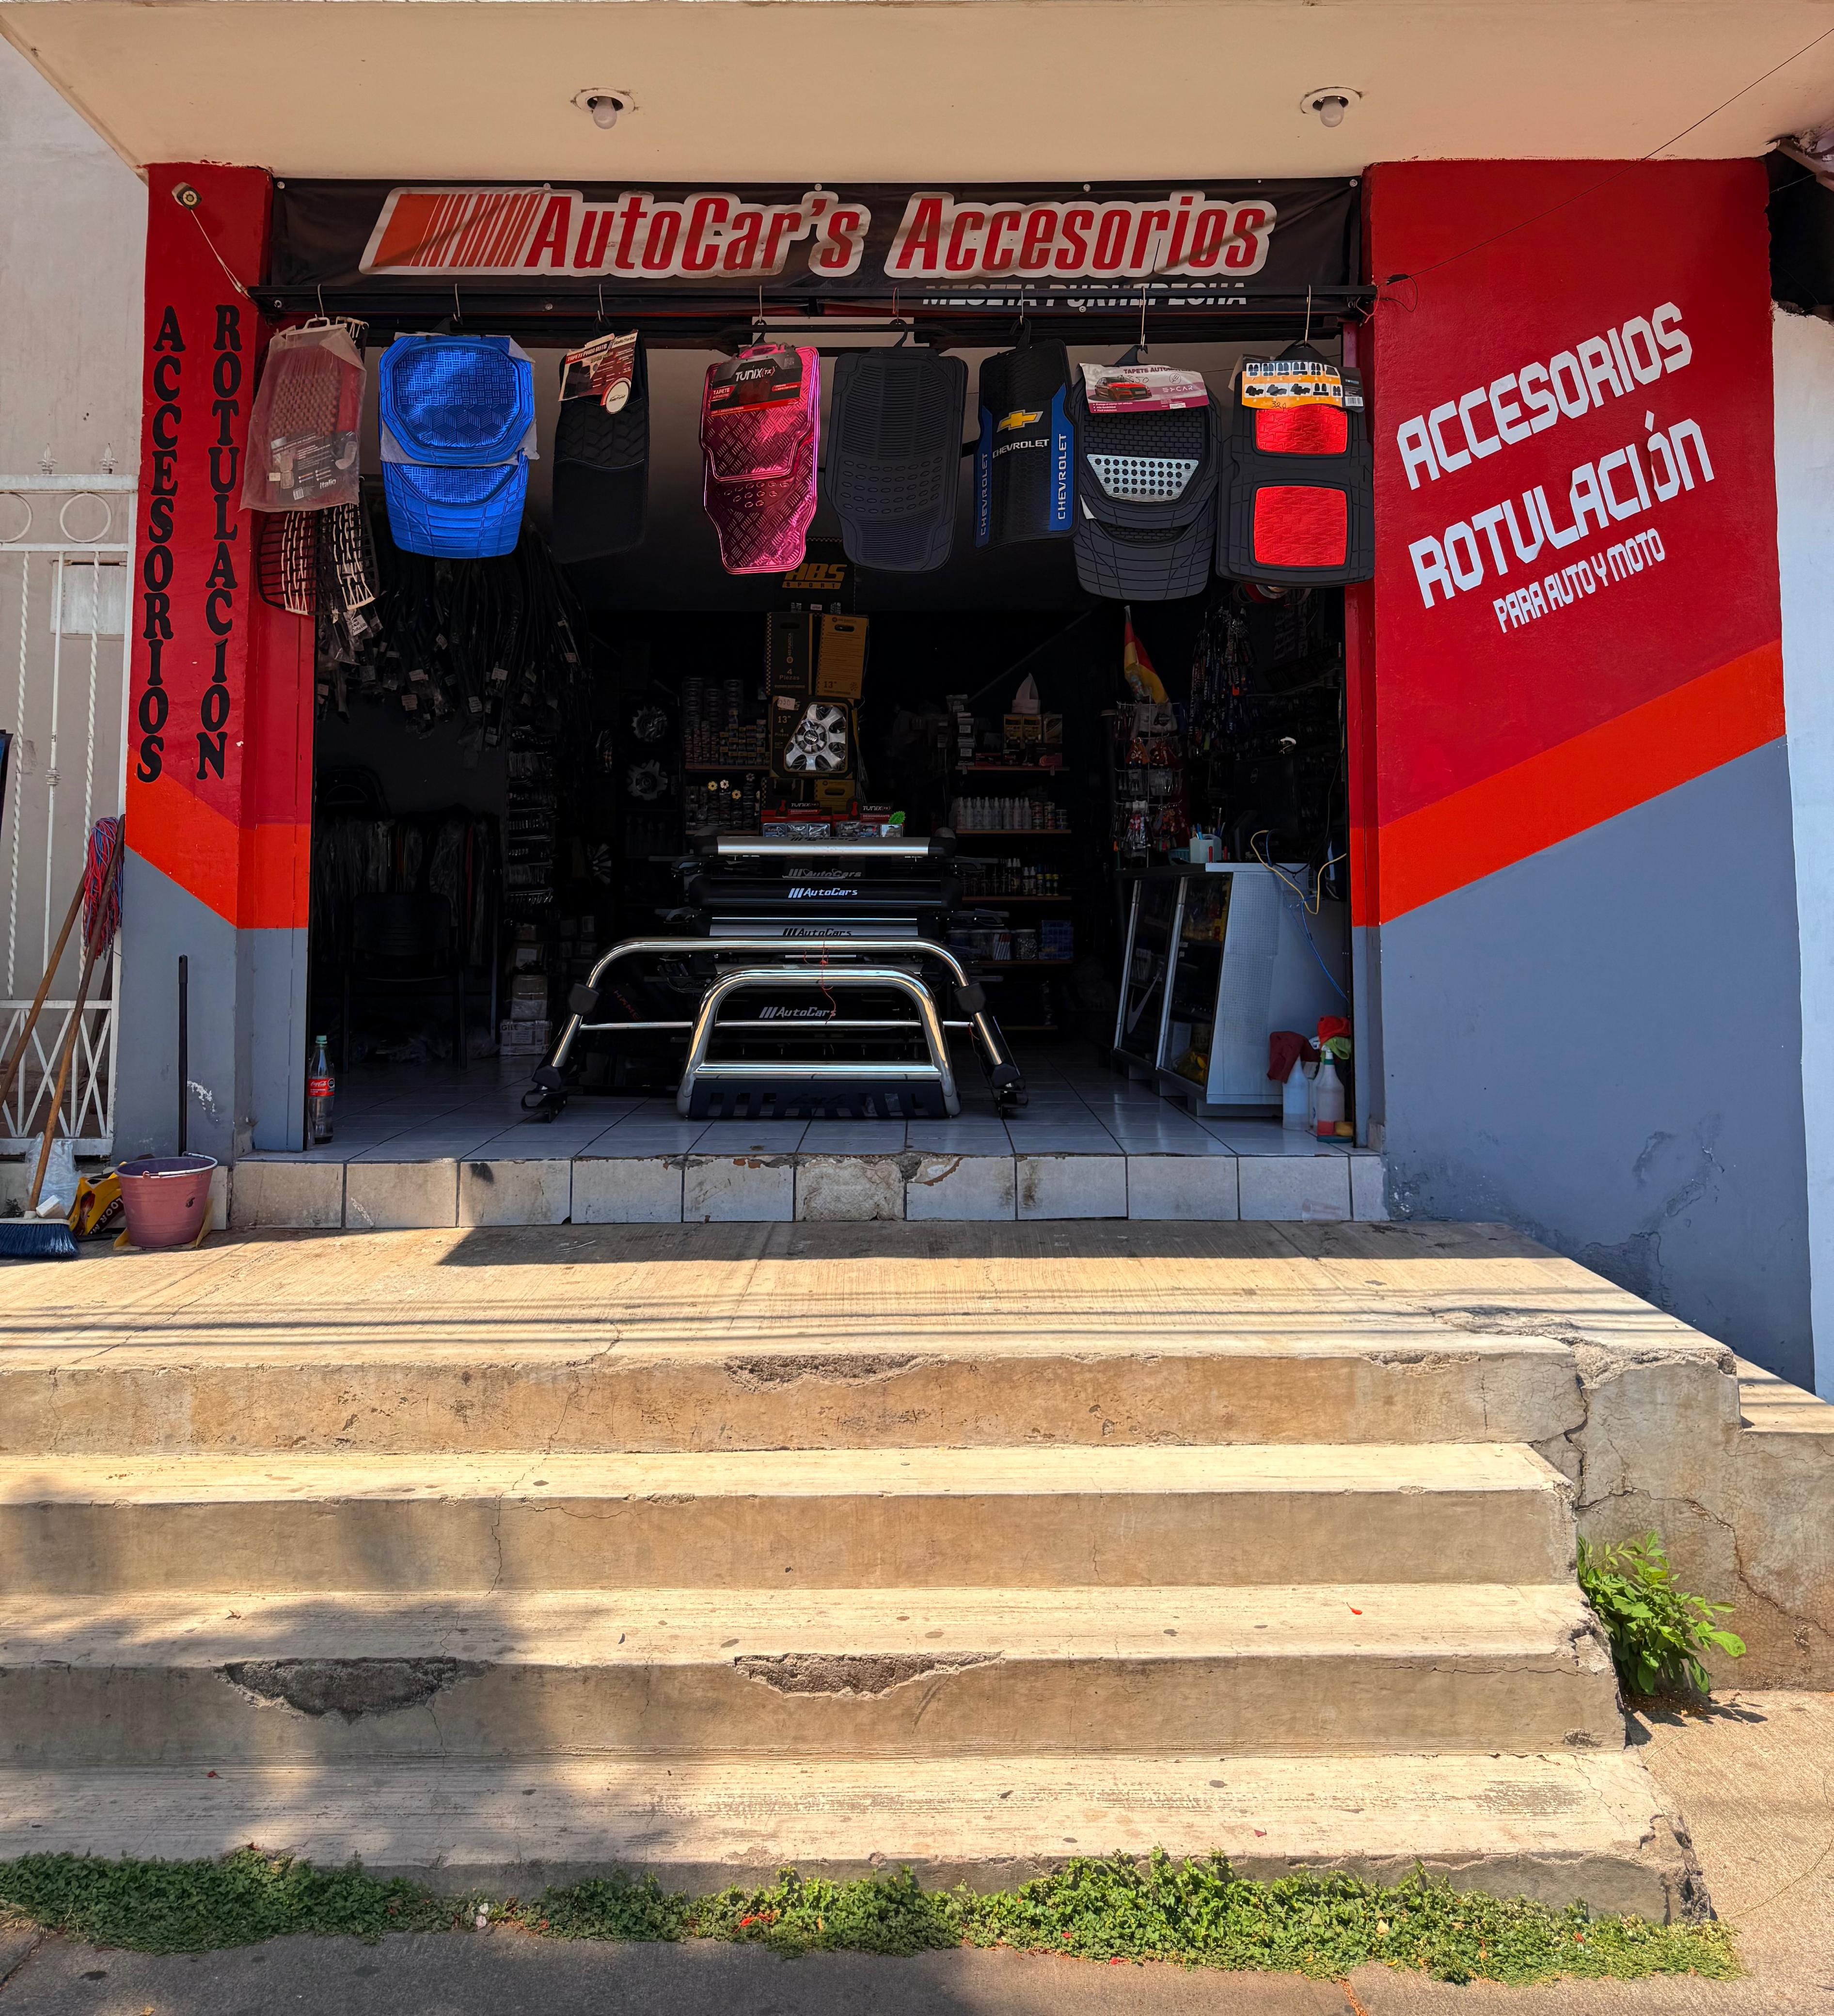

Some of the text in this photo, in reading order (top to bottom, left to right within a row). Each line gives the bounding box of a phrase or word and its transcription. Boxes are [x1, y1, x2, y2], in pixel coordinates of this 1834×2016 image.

[523, 196, 1265, 271] AutoCar's Accesorios
[735, 368, 763, 382] TUNIX
[1396, 301, 1692, 490] ACCESORIOS
[992, 439, 1049, 458] CHEVROLET
[1058, 433, 1067, 520] CHEVROLET
[137, 305, 186, 783] ACCESORIOS
[196, 304, 242, 780] ROTULACION
[1492, 528, 1665, 633] PARA AUTO Y MOTO
[803, 887, 858, 898] AutoCars
[797, 928, 852, 937] AutoCars
[776, 1007, 837, 1018] AutoCars
